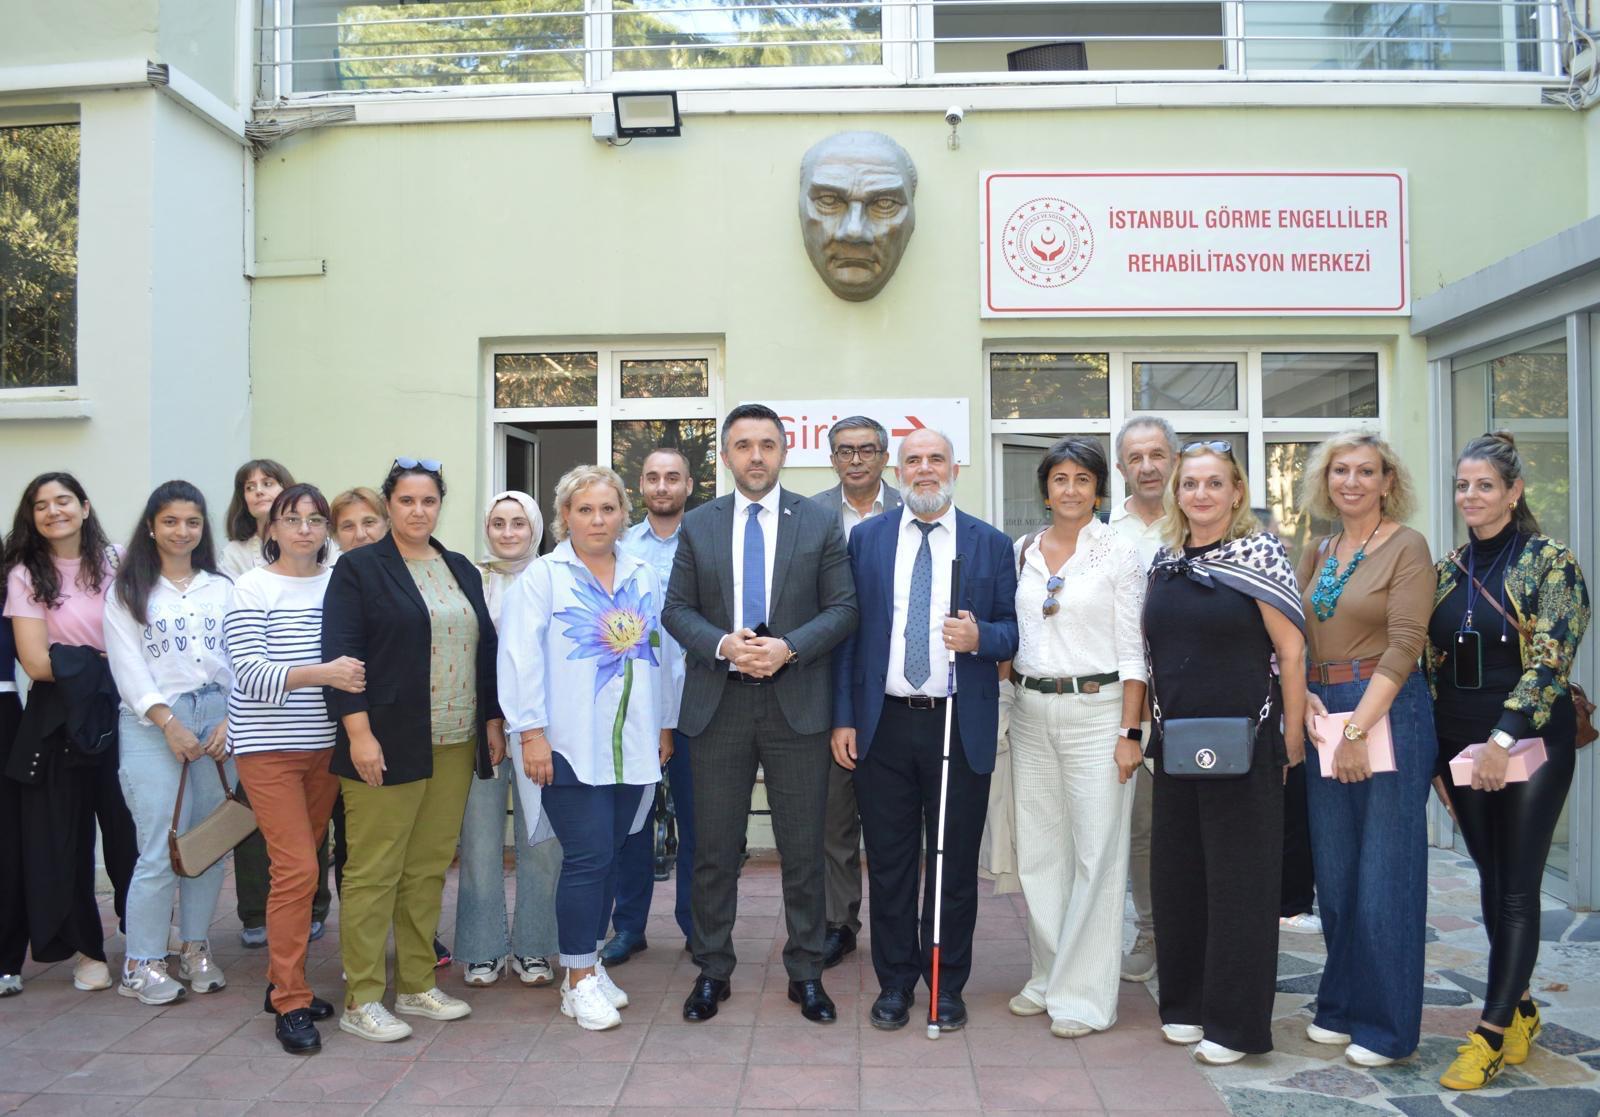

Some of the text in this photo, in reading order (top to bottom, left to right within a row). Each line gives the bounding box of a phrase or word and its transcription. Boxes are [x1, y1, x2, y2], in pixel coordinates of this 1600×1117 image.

[1109, 206, 1388, 229] İSTANBUL GÖRME ENGELLİLER
[1128, 249, 1371, 272] REHABİLİTASYON MERKEZİ
